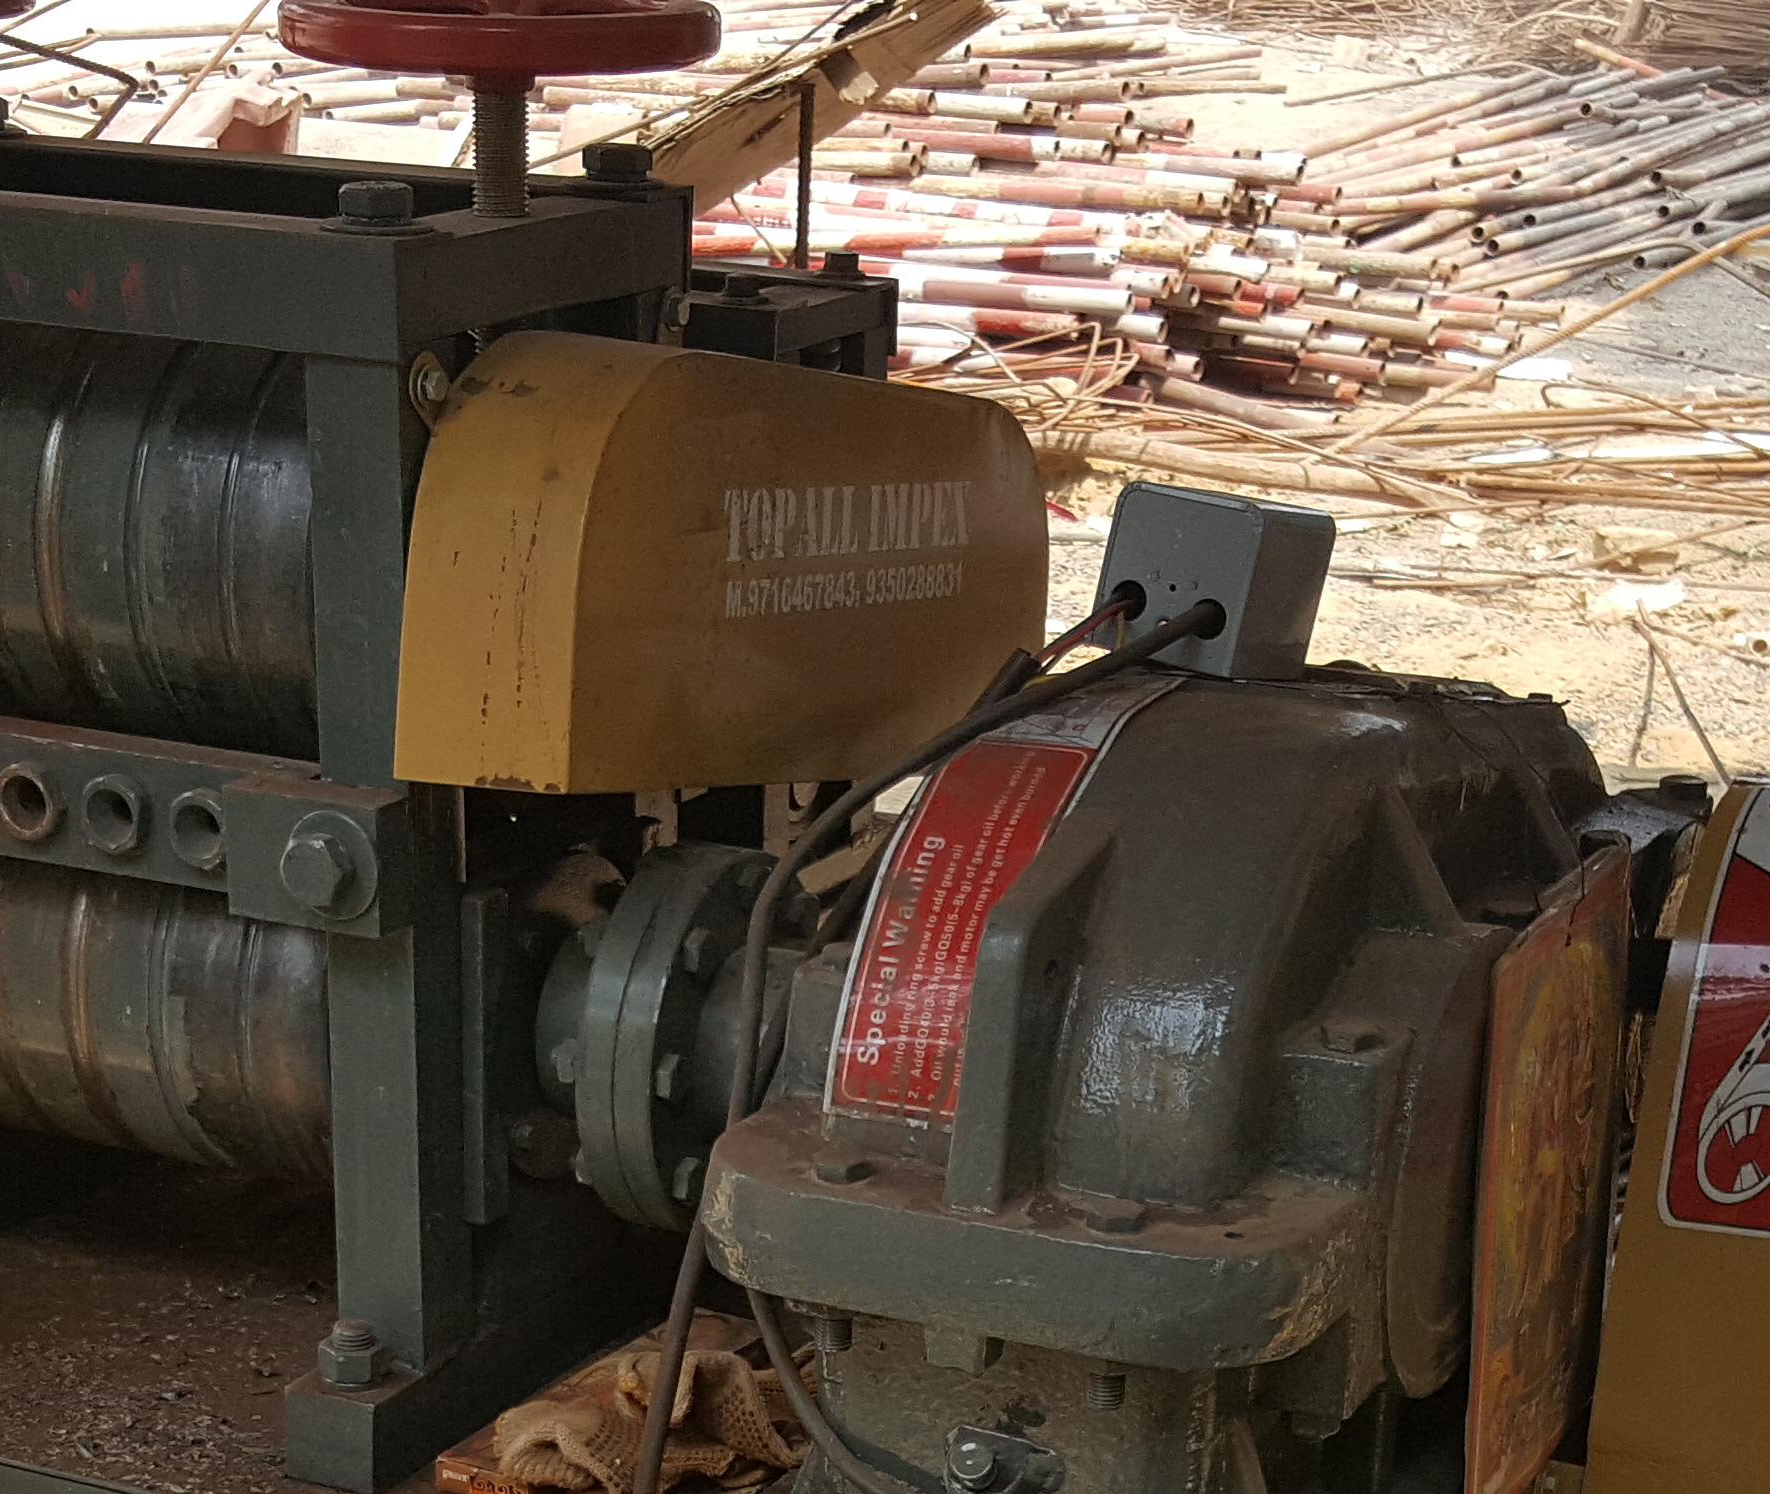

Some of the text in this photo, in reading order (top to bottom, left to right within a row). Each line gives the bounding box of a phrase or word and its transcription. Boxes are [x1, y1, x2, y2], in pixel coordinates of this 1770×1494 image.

[868, 481, 972, 552] IMPEX
[996, 826, 1015, 847] hot
[971, 838, 989, 865] gear
[966, 865, 977, 879] of
[982, 869, 997, 885] be
[915, 930, 932, 971] screw
[926, 915, 937, 929] to
[932, 889, 947, 913] add
[941, 861, 958, 888] gear
[951, 844, 965, 860] oil
[974, 886, 992, 912] may
[960, 912, 980, 953] motor
[953, 954, 968, 980] and
[856, 956, 900, 1066] Special
[937, 1013, 953, 1059] would
[930, 1061, 944, 1081] Oil
